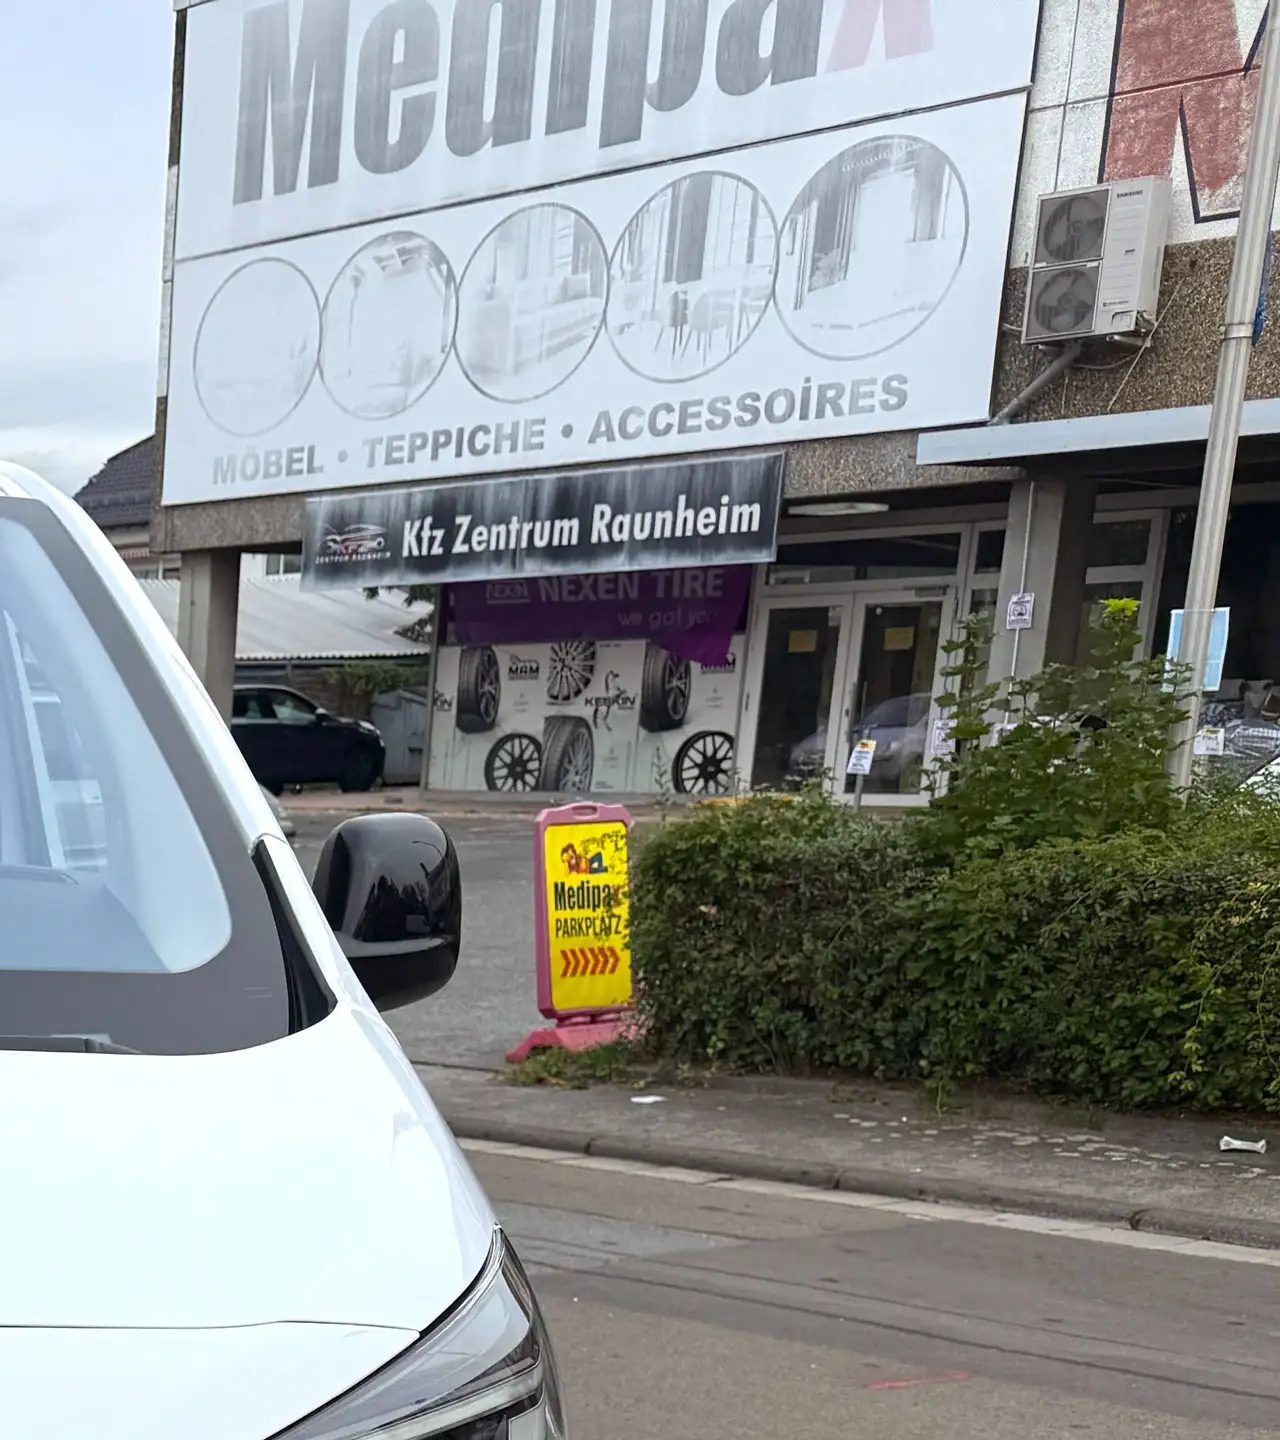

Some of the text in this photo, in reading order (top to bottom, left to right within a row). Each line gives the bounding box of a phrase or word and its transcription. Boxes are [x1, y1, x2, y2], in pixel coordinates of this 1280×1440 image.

[212, 444, 324, 486] MÖBEL
[362, 416, 547, 470] TEPPICHE
[402, 494, 761, 558] Kfz Zentrum Raunheim
[537, 567, 726, 603] NEXEN TIRE
[555, 915, 622, 939] PARKPLATZ
